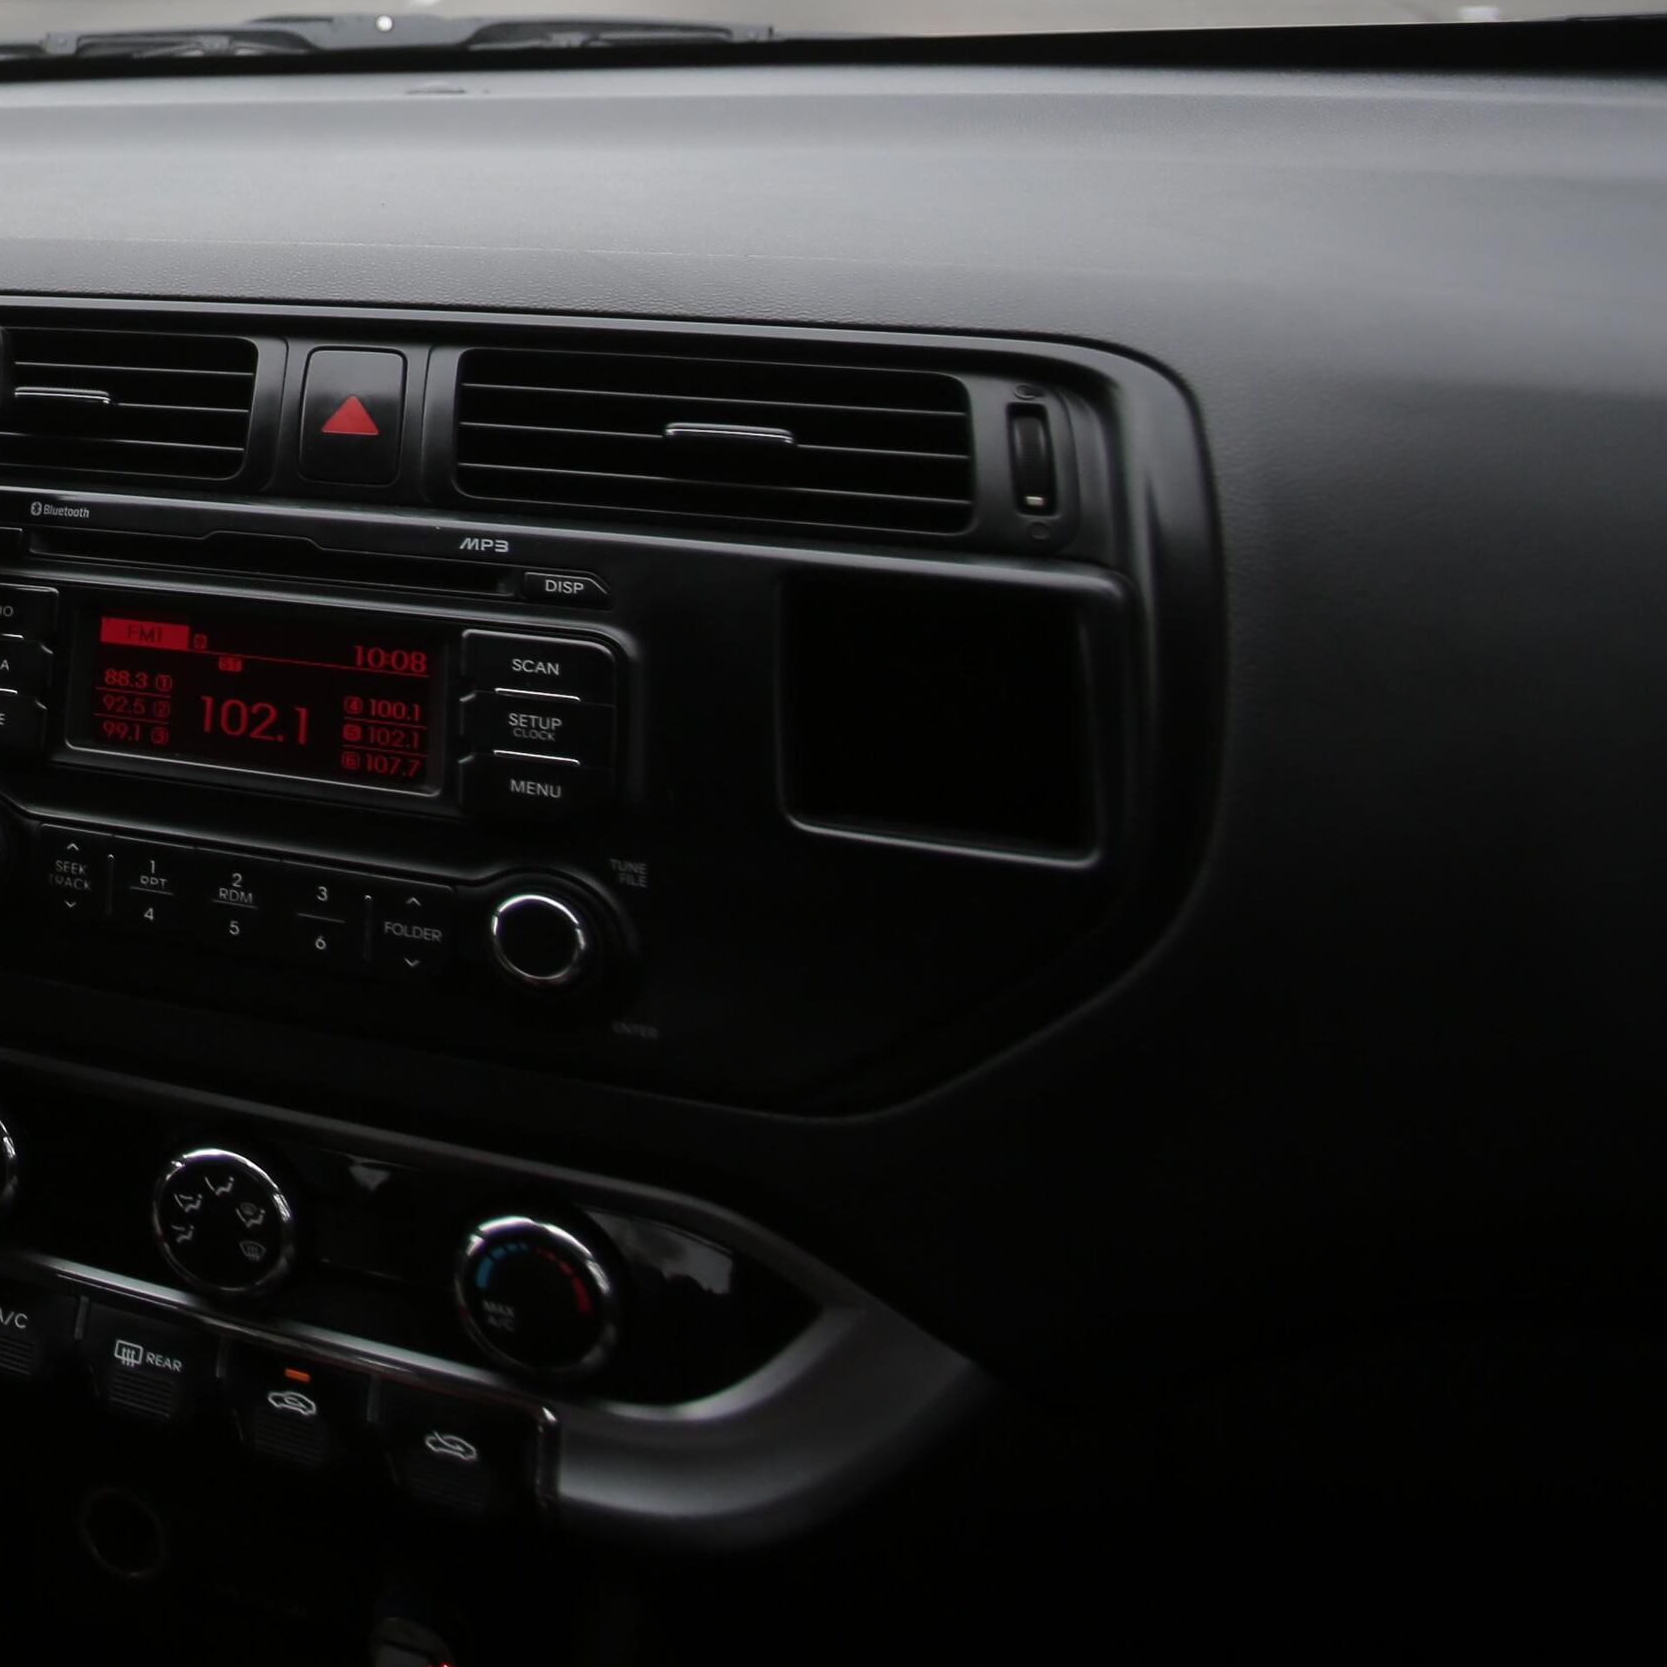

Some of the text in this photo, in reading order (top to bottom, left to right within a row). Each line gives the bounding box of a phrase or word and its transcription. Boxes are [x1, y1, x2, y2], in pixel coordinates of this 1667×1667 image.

[43, 503, 90, 519] Bluetooth
[460, 537, 509, 553] MP3
[545, 579, 584, 594] DISP
[353, 645, 428, 674] 10:08
[512, 658, 560, 676] SCAN
[104, 668, 149, 689] 88.3
[102, 693, 146, 714] 92.5
[369, 698, 421, 722] 100.1
[200, 695, 309, 746] 102.1
[508, 713, 562, 731] SETUP
[102, 718, 141, 742] 99.1
[368, 727, 420, 750] 102.1
[513, 727, 555, 741] CLOCK
[366, 753, 422, 779] 107.7
[510, 779, 562, 799] MENU
[55, 860, 87, 876] SEEK
[149, 860, 157, 874] 1
[610, 858, 647, 876] TUNE
[48, 873, 92, 892] TRACK
[231, 872, 243, 888] 2
[619, 872, 647, 888] FILE
[218, 887, 253, 905] RDM
[316, 886, 328, 902] 3
[143, 907, 155, 921] 4
[229, 920, 240, 935] 5
[384, 921, 443, 943] FOLDER
[315, 935, 327, 950] 6
[145, 1351, 183, 1373] REAR
